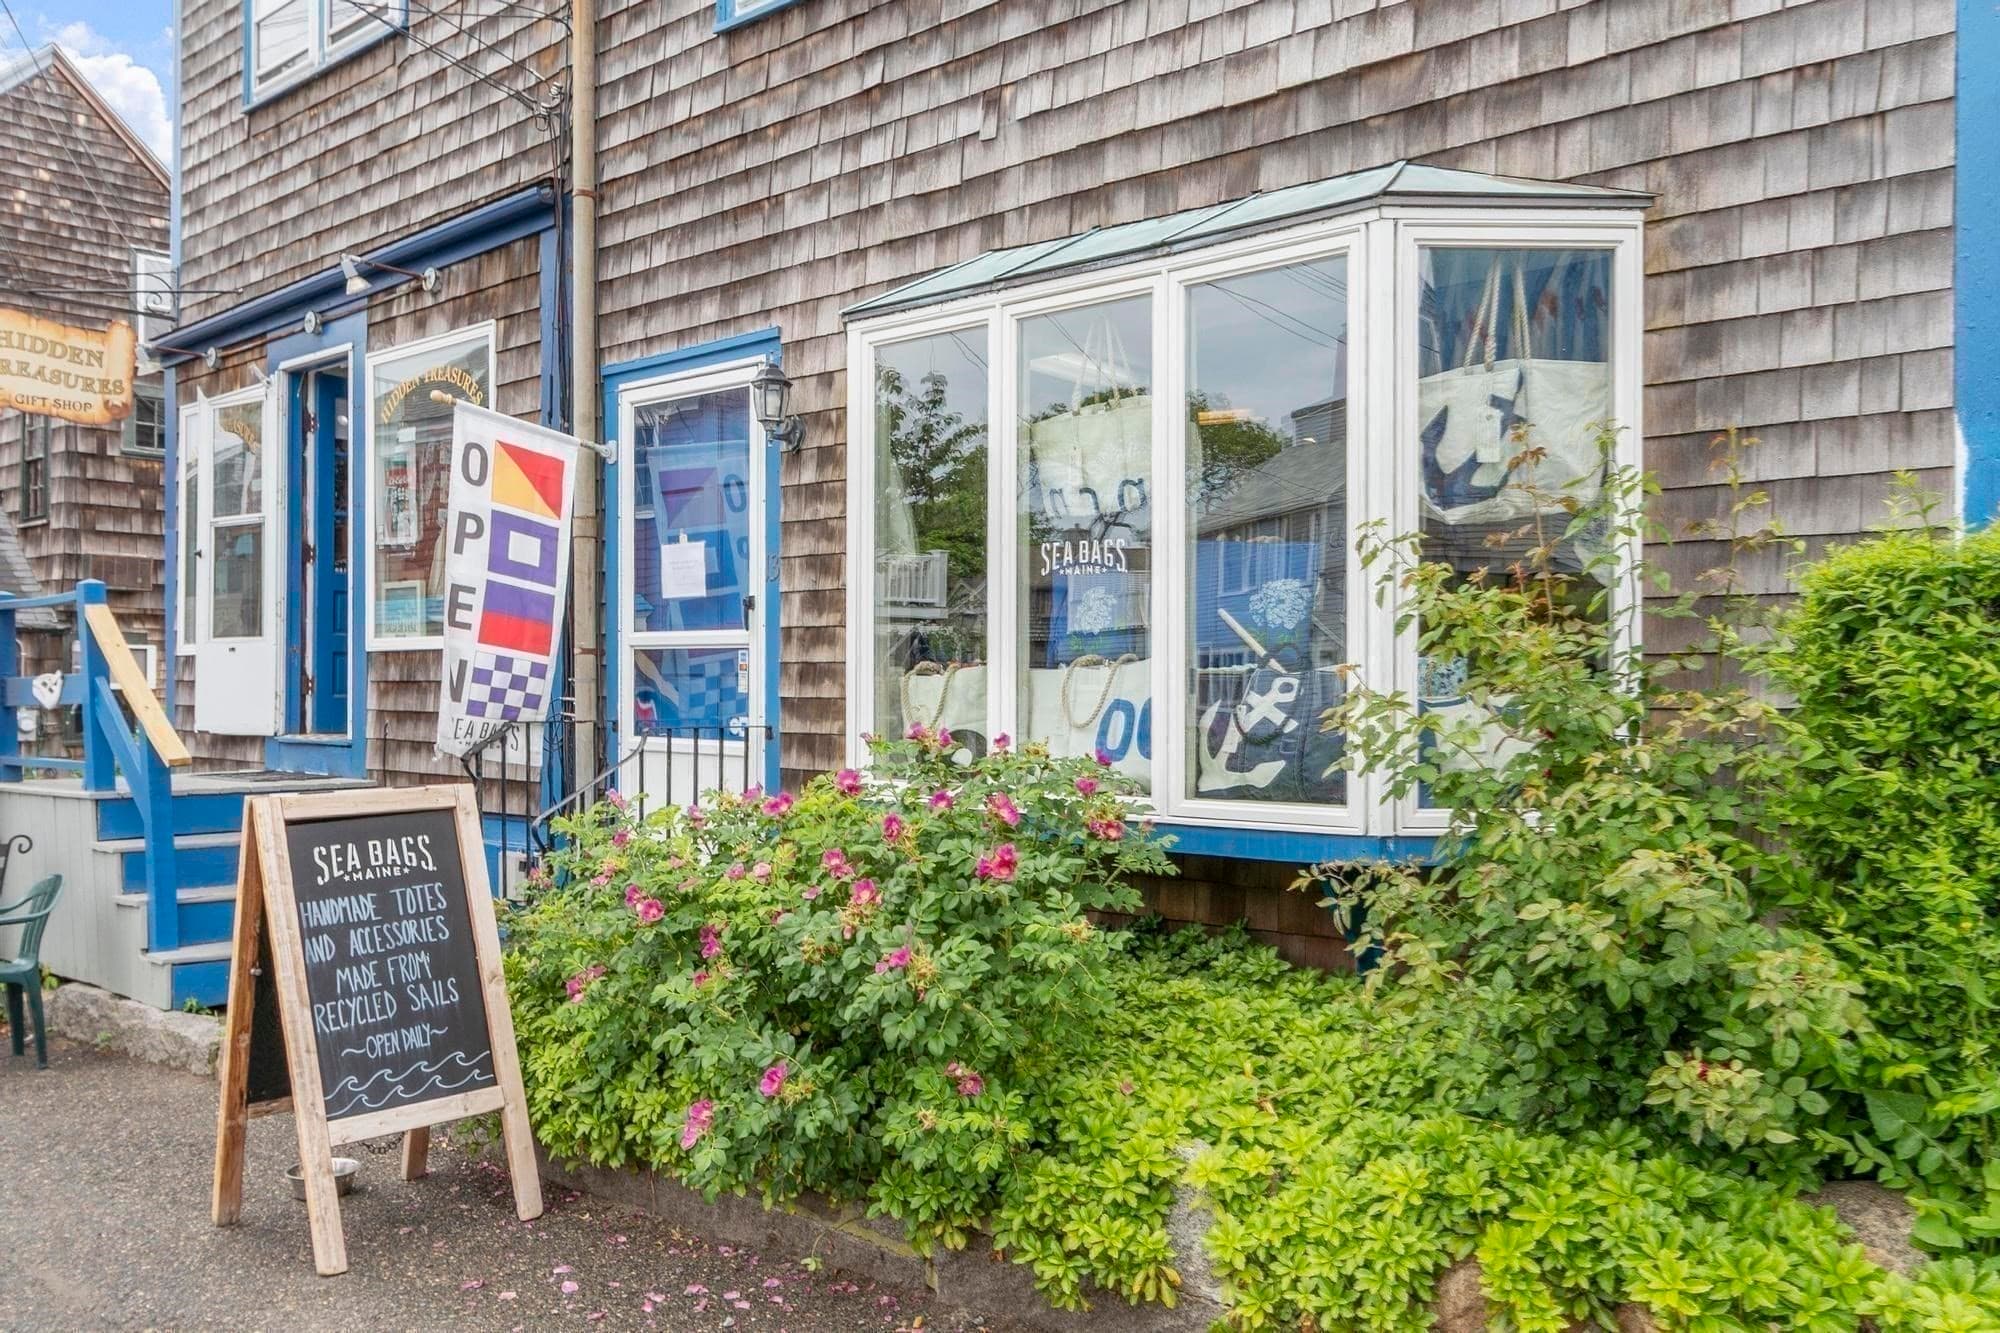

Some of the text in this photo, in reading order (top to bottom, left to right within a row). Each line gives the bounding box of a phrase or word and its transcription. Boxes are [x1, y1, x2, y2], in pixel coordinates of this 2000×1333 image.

[0, 330, 105, 369] HIDDEN
[0, 358, 125, 395] REASURES
[382, 366, 483, 425] HIDDEN TREASURES
[15, 394, 92, 412] GIFT SHOP
[447, 441, 489, 703] OPEN
[1041, 538, 1126, 577] SEA BAGS
[1065, 564, 1100, 576] MAINE
[313, 834, 437, 886] SEA BAGS
[352, 866, 402, 882] MAINE
[300, 882, 448, 930] HANDMADE TOTES
[304, 915, 450, 965] AND ACCESSORIES
[336, 950, 432, 995] MADE FROM
[314, 977, 460, 1034] RECYCLED SAILS
